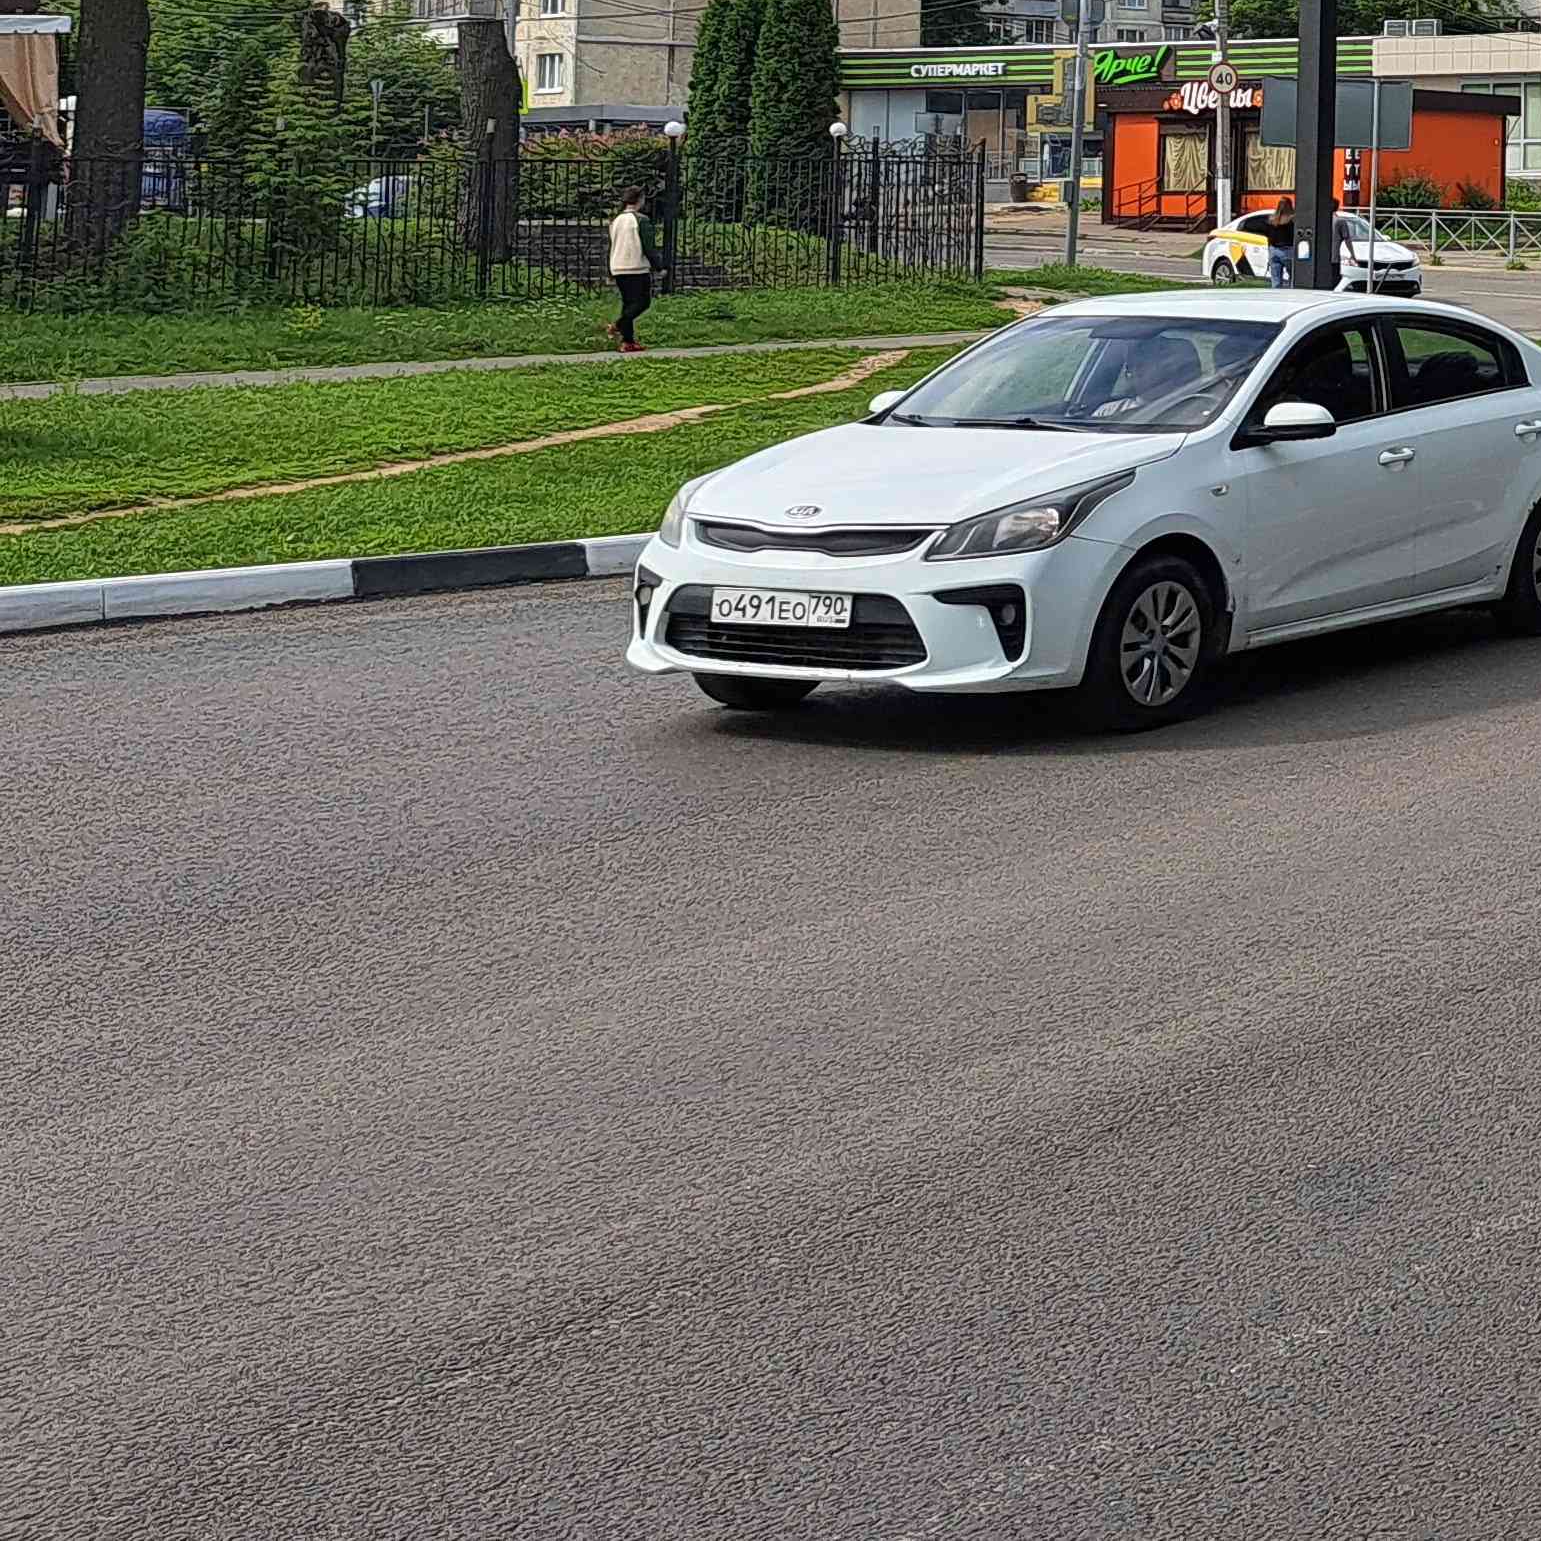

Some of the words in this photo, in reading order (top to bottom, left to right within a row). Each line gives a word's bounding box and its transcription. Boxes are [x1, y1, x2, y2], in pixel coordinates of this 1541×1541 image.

[910, 62, 1007, 78] СУПЕРМАРКЕТ
[1094, 44, 1173, 82] Ярче!
[1215, 73, 1233, 85] 40
[1180, 81, 1253, 115] Цвеы
